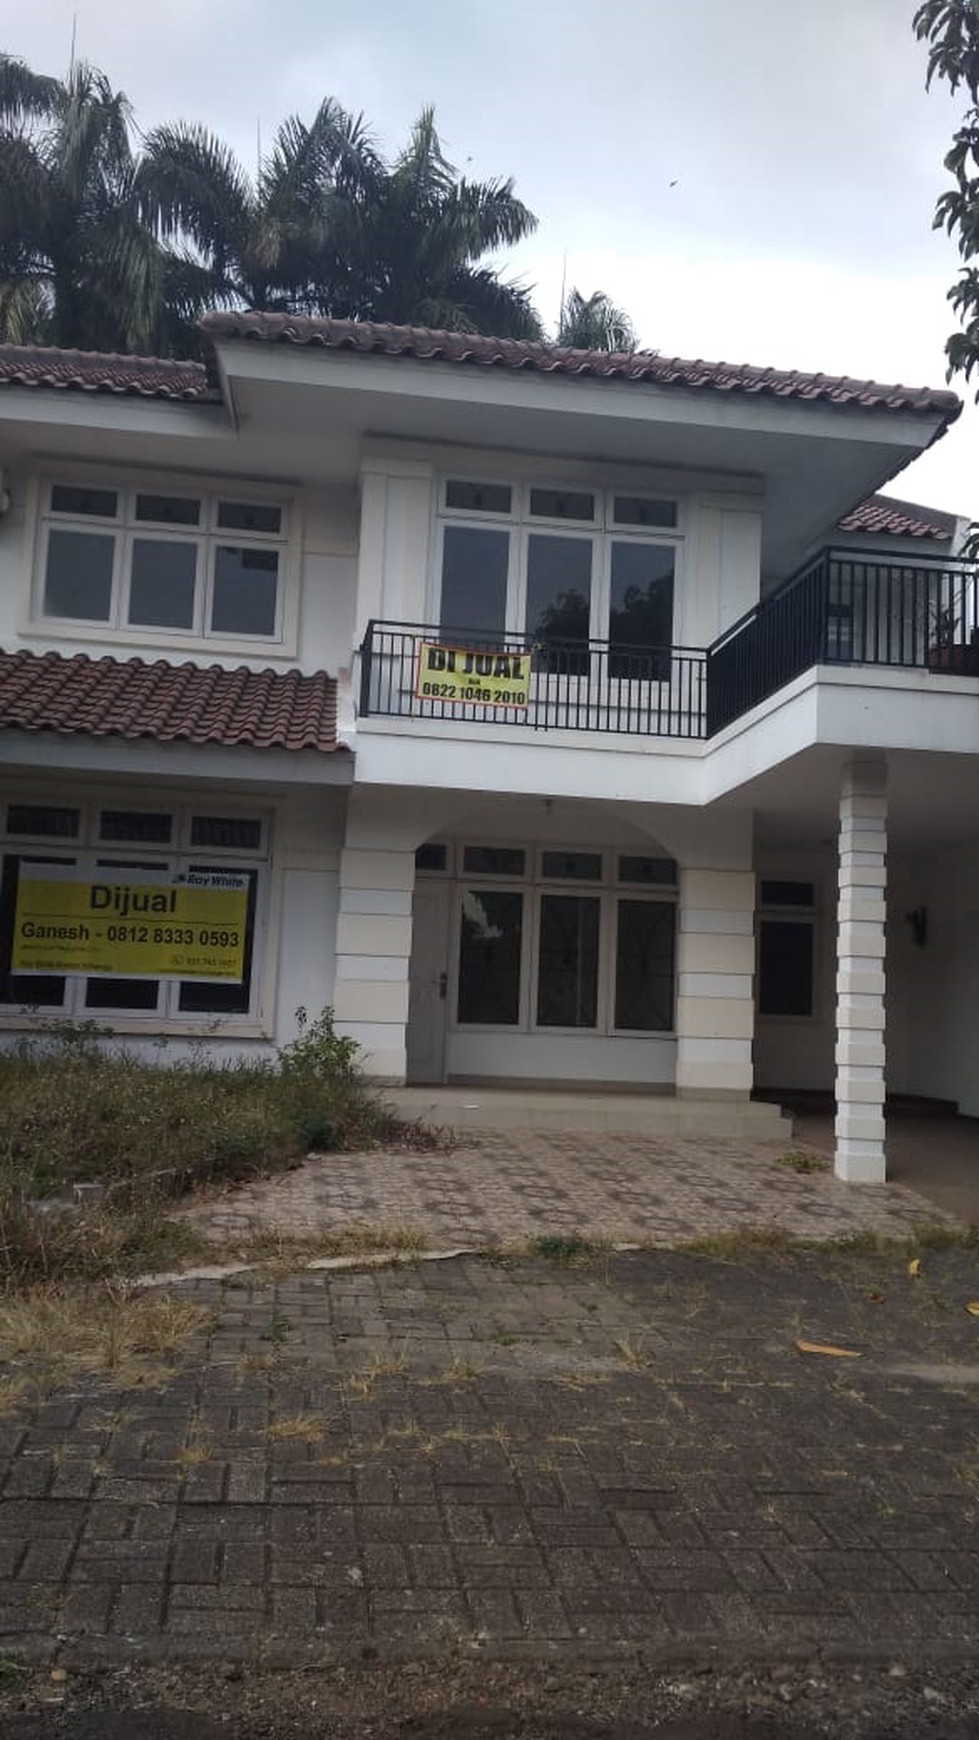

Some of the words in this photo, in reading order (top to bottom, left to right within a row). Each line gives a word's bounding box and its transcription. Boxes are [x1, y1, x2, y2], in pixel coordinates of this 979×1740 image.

[428, 648, 456, 673] DI
[462, 653, 524, 680] JUAL
[423, 682, 456, 698] 0822
[460, 687, 491, 702] 1046
[494, 690, 525, 705] 2010
[90, 886, 177, 915] Dijual
[22, 922, 90, 940] Ganesh
[107, 925, 148, 943] 0812
[153, 927, 194, 945] 8333
[199, 930, 240, 948] 0593
